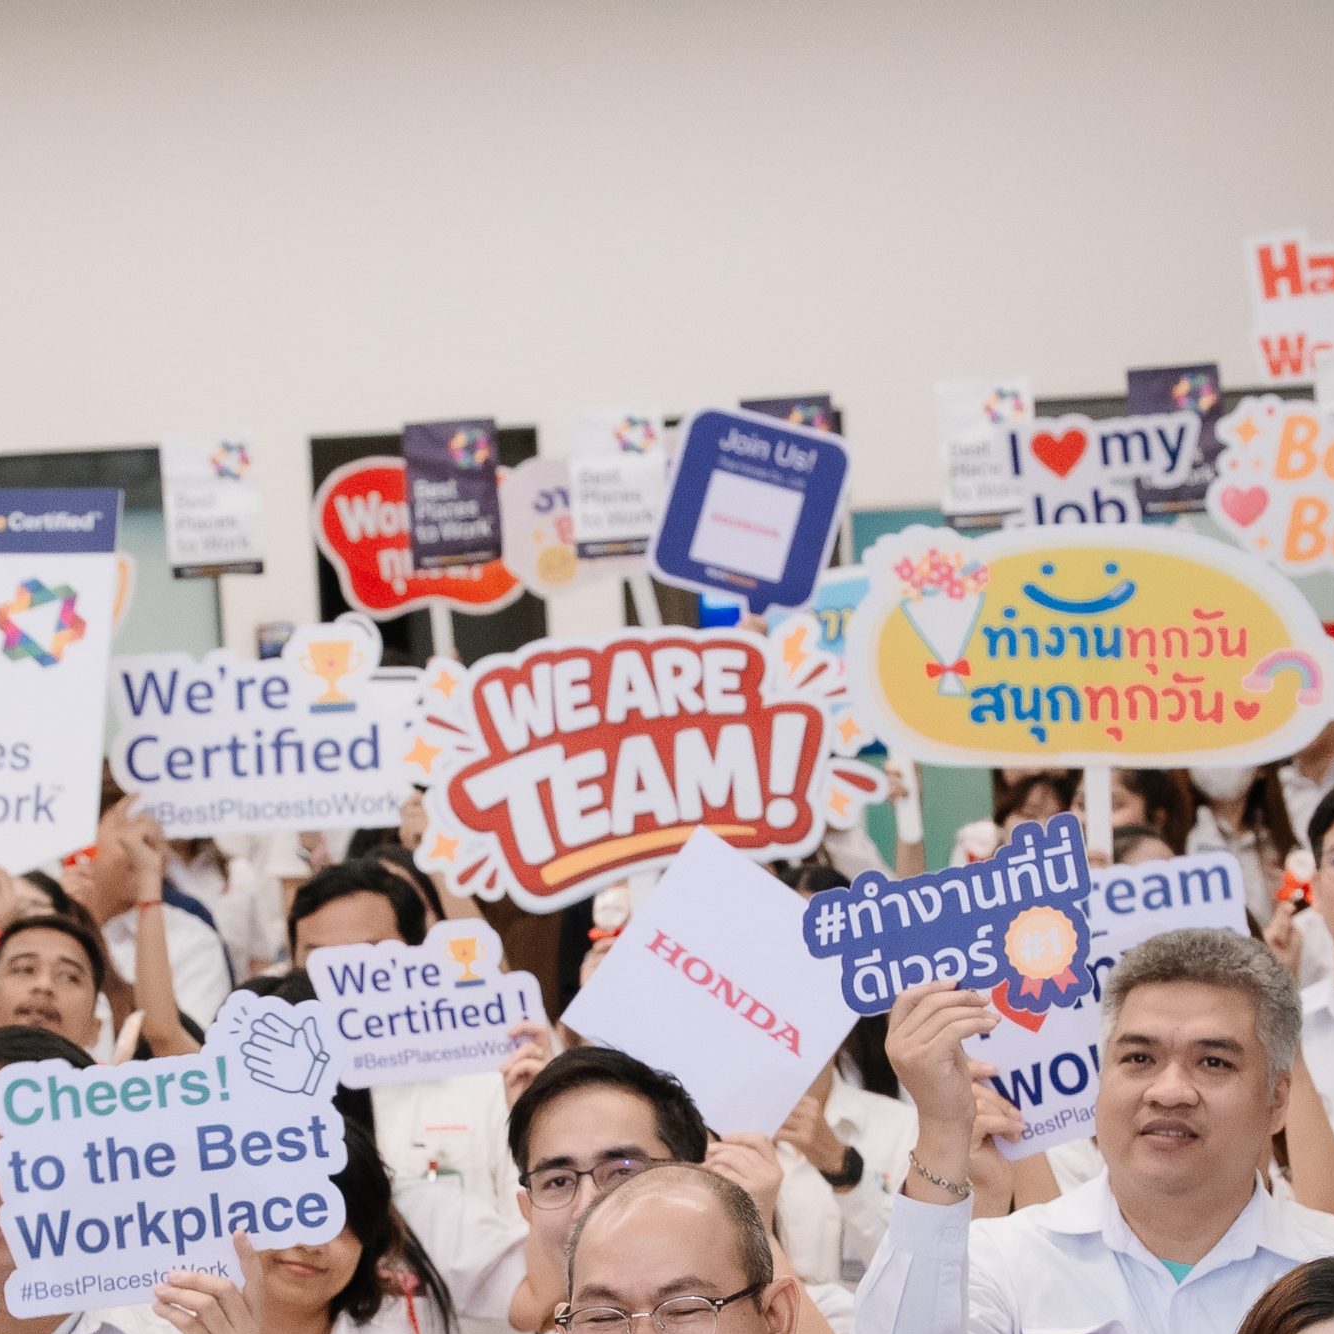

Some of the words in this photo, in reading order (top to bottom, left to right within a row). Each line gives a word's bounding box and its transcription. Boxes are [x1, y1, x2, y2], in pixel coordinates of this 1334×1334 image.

[1100, 427, 1185, 473] my
[981, 605, 1249, 676] ทำงานทุกวัน
[482, 657, 601, 754] WE
[606, 646, 748, 724] ARE
[969, 671, 1225, 744] สนุกทุกวัน
[126, 722, 381, 783] Certified
[462, 712, 808, 866] TEAM!
[814, 826, 1079, 947] #ทำงานที่นี่
[644, 928, 802, 1058] HONDA
[853, 924, 998, 1003] ดีเวอร์
[338, 991, 506, 1041] Certified
[3, 1055, 230, 1126] Cheers!
[9, 1151, 65, 1194] to
[83, 1136, 177, 1185] the
[196, 1115, 330, 1172] Best
[15, 1191, 329, 1261] Workplace
